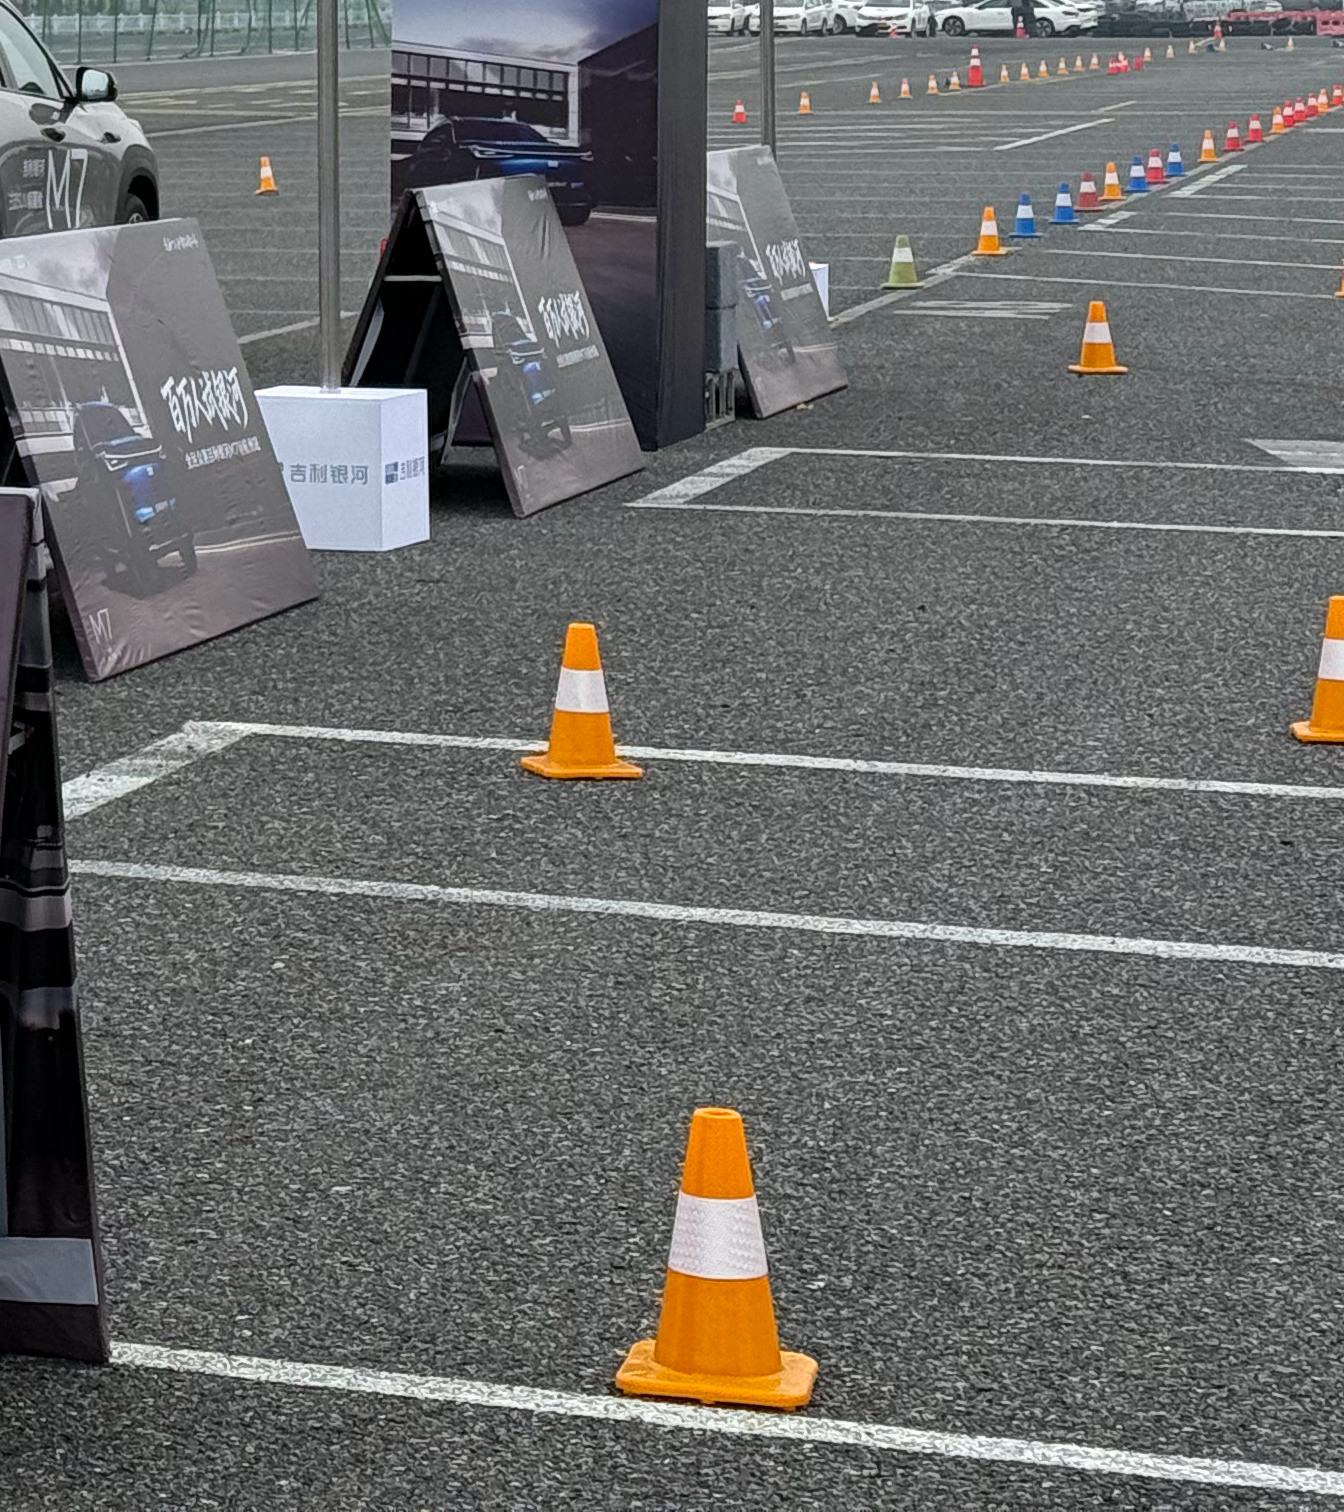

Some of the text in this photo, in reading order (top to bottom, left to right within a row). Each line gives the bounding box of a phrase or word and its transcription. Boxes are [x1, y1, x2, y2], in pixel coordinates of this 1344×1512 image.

[46, 148, 89, 229] M7
[290, 463, 369, 485] 吉利银河
